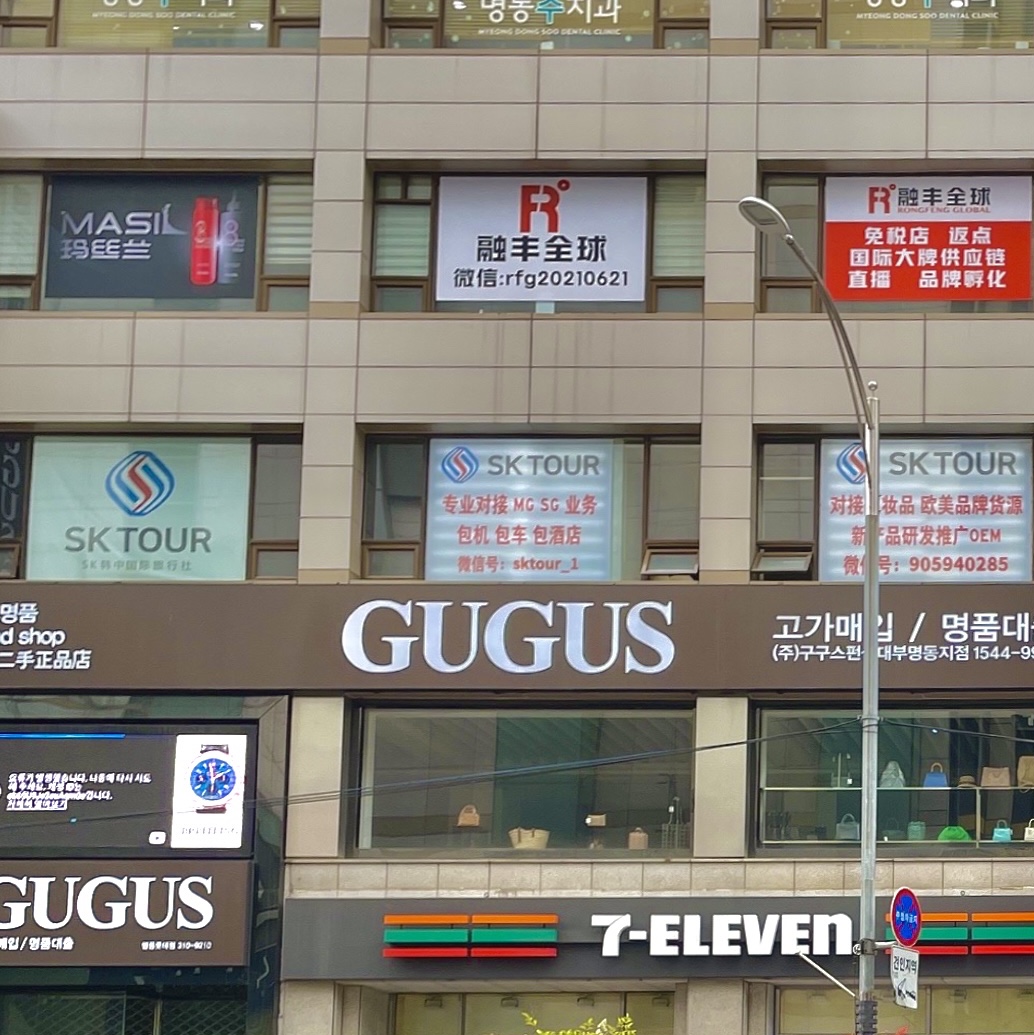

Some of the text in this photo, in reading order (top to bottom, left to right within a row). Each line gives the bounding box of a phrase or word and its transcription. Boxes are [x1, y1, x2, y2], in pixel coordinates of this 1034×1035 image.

[478, 28, 621, 36] MYEONG DONG SOO DENTAL CLINIC
[898, 187, 991, 206] 融丰全球
[864, 226, 992, 245] 免税店 返点
[477, 235, 607, 262] 融丰全球
[850, 248, 1006, 267] 国际大牌供应链
[848, 270, 1007, 289] 直播 品牌孵化
[442, 495, 598, 515] 专业对接 MG SG 业务
[830, 495, 1023, 515] 对接妆品 欧美品牌货源
[457, 525, 582, 545] 包机 包车 包酒店
[513, 557, 578, 573] sktour_1
[909, 556, 1008, 573] 905940285
[0, 602, 39, 624] 명품
[0, 627, 66, 647] d shop
[341, 599, 676, 674] GUGUS
[0, 650, 92, 670] 二手正品店
[0, 876, 214, 930] GUGUS
